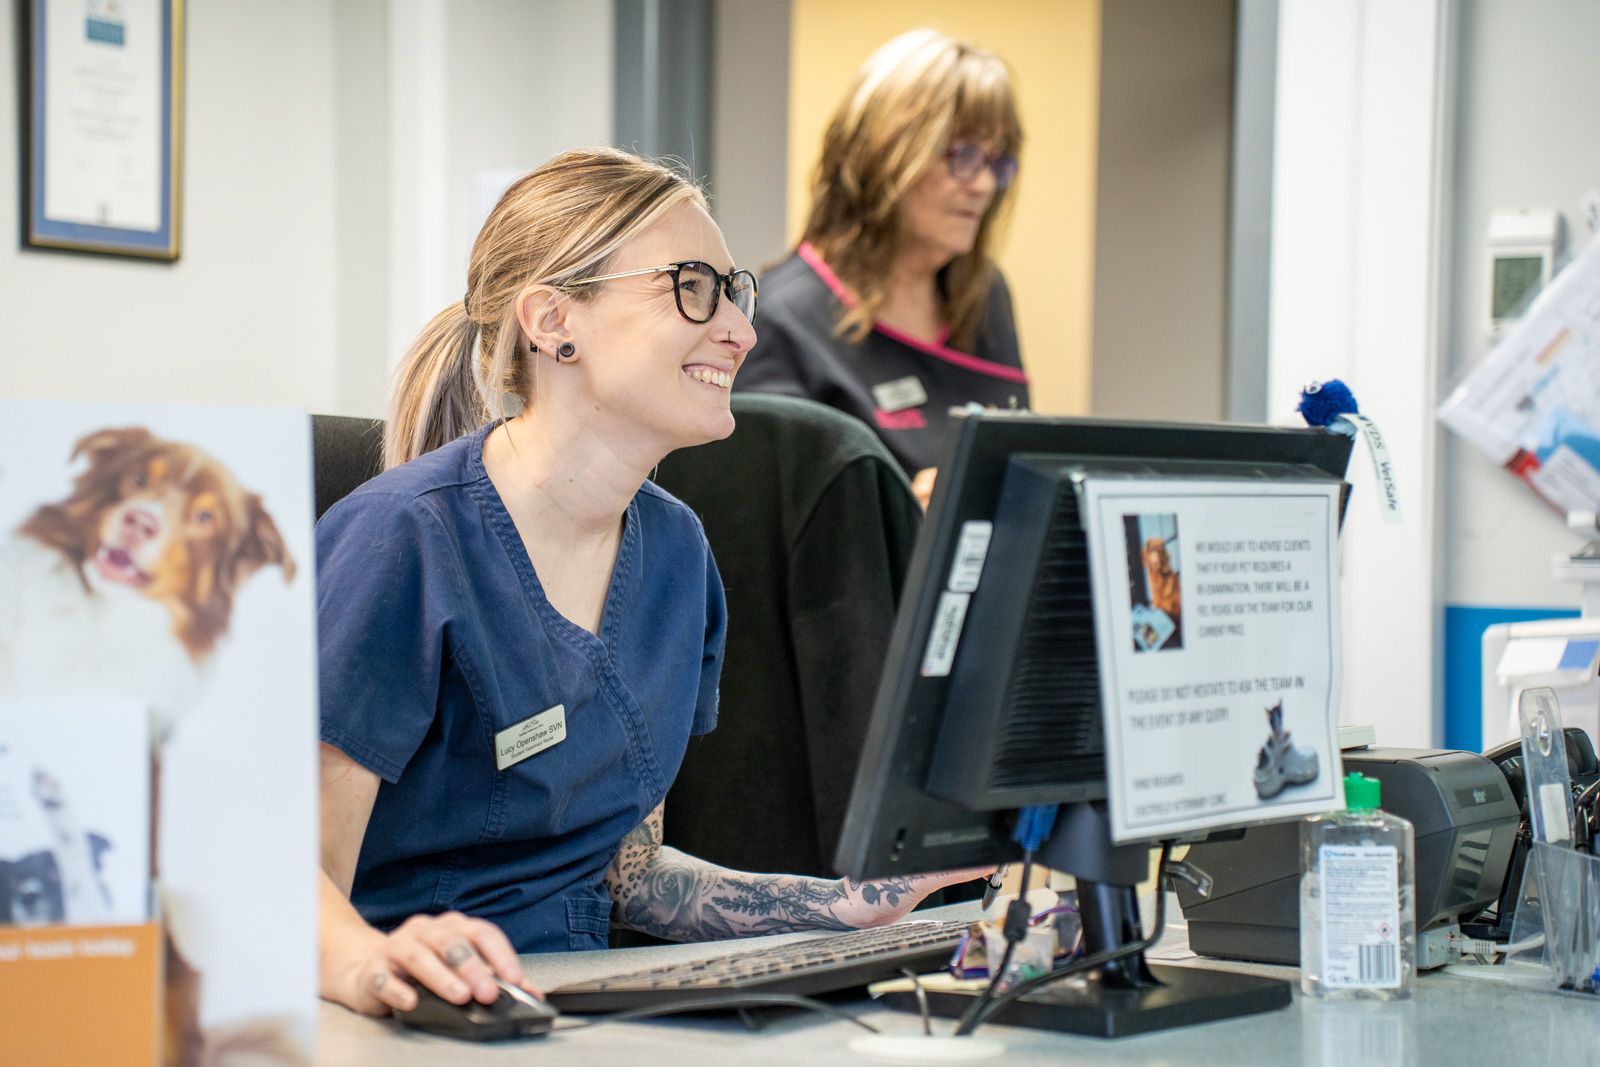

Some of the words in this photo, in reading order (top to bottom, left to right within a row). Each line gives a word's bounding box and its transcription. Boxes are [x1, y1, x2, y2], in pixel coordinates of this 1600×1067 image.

[1381, 461, 1397, 511] VetSafe
[1208, 541, 1232, 552] WOULD
[1233, 541, 1246, 552] LIKE
[1248, 540, 1258, 552] TO
[1259, 540, 1282, 552] ADVISE
[1284, 539, 1311, 551] CLIENTS
[1221, 562, 1238, 573] YOUR
[1239, 561, 1251, 572] PET
[1252, 561, 1286, 572] REQUIRES
[1253, 582, 1274, 593] THERE
[1275, 581, 1291, 593] WILL
[1294, 581, 1304, 592] BE
[1211, 604, 1232, 616] PLEASE
[1247, 602, 1259, 614] THE
[1261, 602, 1280, 613] TEAM
[1281, 601, 1295, 612] FOR
[1296, 600, 1313, 612] OUR
[1128, 688, 1158, 704] PLEASE
[1174, 685, 1191, 701] NOT
[1193, 682, 1227, 699] HESITATE
[1228, 681, 1240, 696] TO
[1253, 679, 1270, 692] THE
[1270, 677, 1294, 691] TEAM
[1294, 676, 1306, 689] IN
[1149, 714, 1175, 729] EVENT
[500, 745, 515, 756] Lucy
[516, 729, 548, 748] Openshaw
[549, 721, 563, 734] SVN
